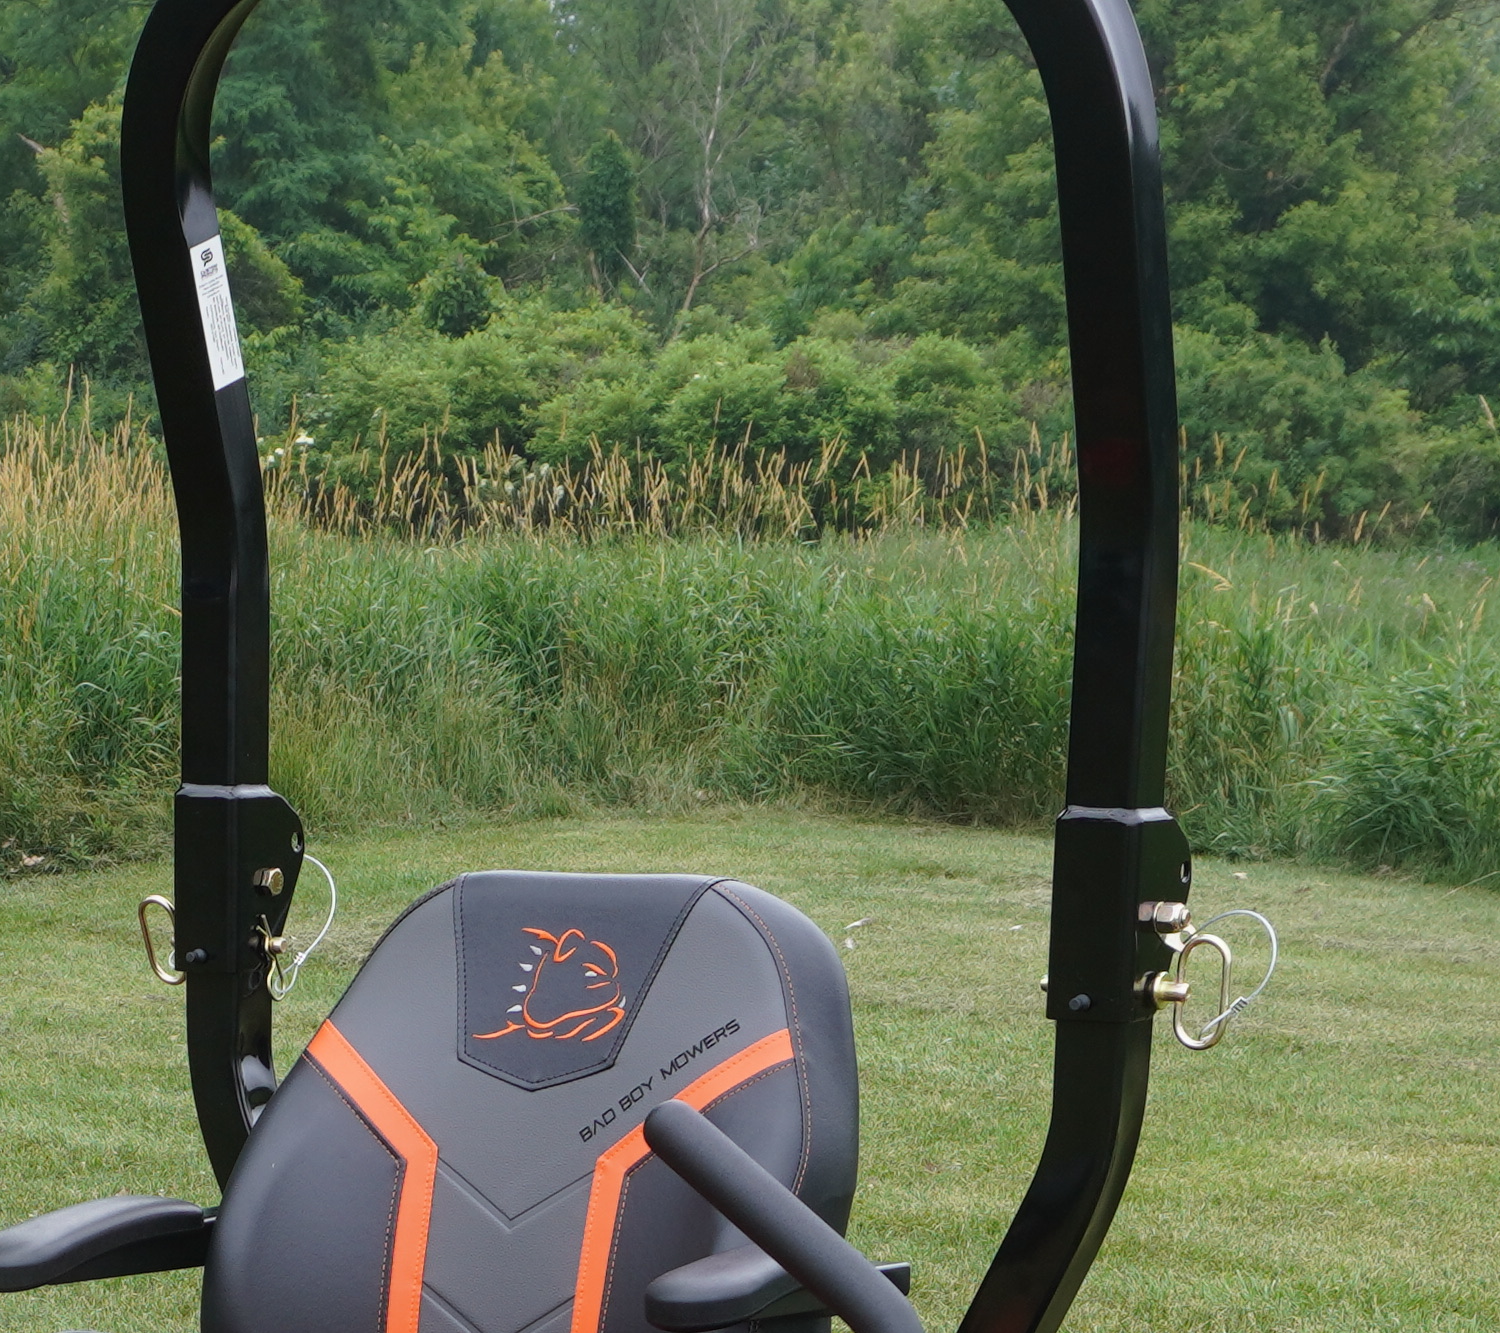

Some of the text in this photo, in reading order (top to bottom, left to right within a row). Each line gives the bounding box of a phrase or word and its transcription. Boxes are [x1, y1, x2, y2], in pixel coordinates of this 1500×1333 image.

[579, 1018, 741, 1142] BAD BOY MOWERS
